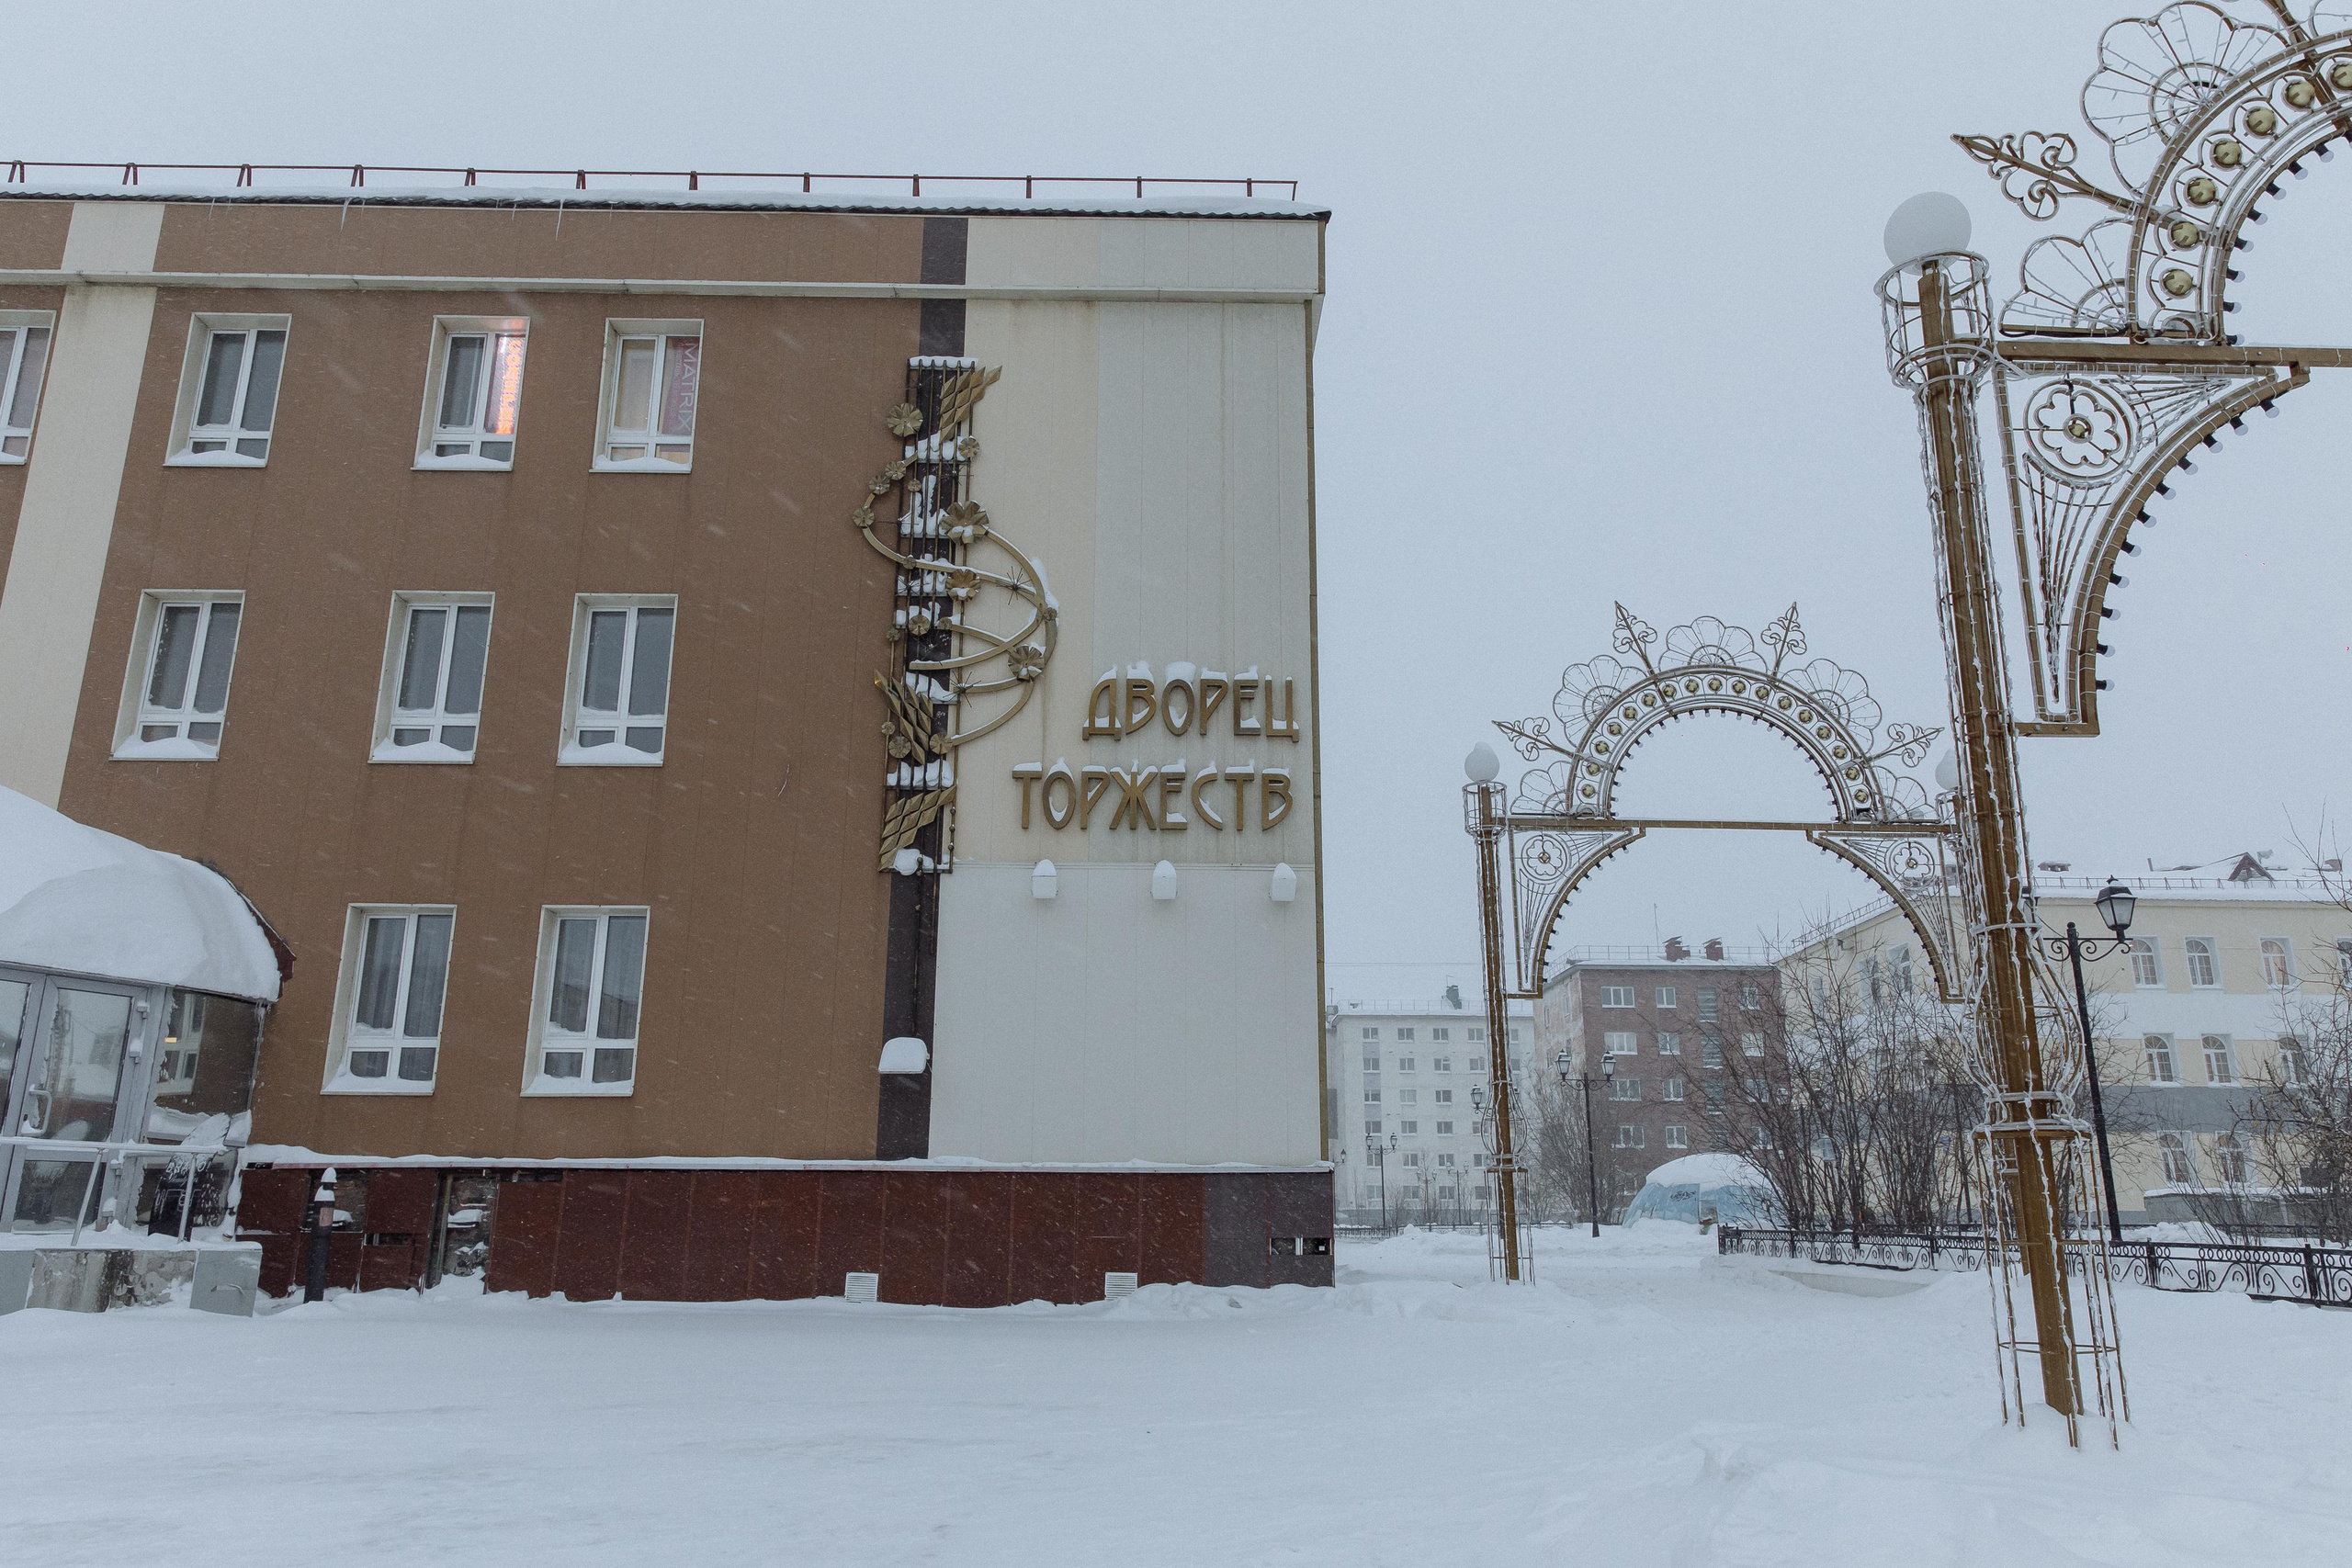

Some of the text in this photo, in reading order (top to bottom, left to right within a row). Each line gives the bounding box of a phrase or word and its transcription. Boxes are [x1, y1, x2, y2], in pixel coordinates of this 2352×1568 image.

[676, 343, 699, 432] MATRIX
[1081, 677, 1299, 743] ДВОРЕЦ
[1012, 768, 1294, 831] ТОРЖЕСТВ
[165, 1161, 212, 1175] BRAO!
